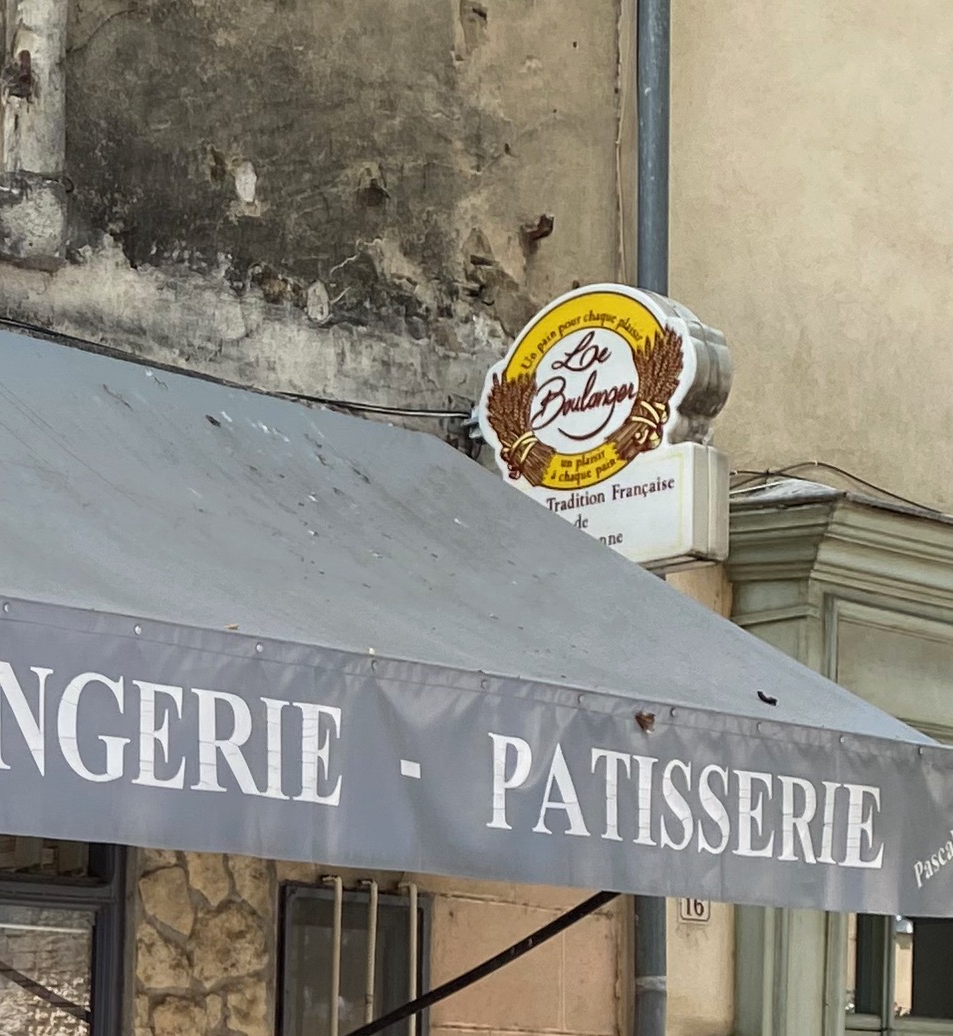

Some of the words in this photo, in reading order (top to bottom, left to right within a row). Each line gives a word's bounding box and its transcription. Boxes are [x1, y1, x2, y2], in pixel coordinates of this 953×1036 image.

[537, 330, 557, 353] pain
[558, 316, 581, 337] pour
[583, 310, 617, 326] chaque
[616, 318, 643, 341] plaisir
[531, 370, 638, 438] Boulanger
[558, 469, 592, 486] chaque
[595, 458, 617, 479] pain
[561, 459, 573, 468] un
[576, 449, 606, 470] plaisir
[546, 490, 606, 512] Tradition
[611, 476, 675, 501] Française
[574, 513, 588, 529] de
[400, 760, 422, 779] -
[486, 731, 886, 870] PATISSERIE
[913, 829, 953, 889] Pasca
[686, 898, 705, 917] 16
